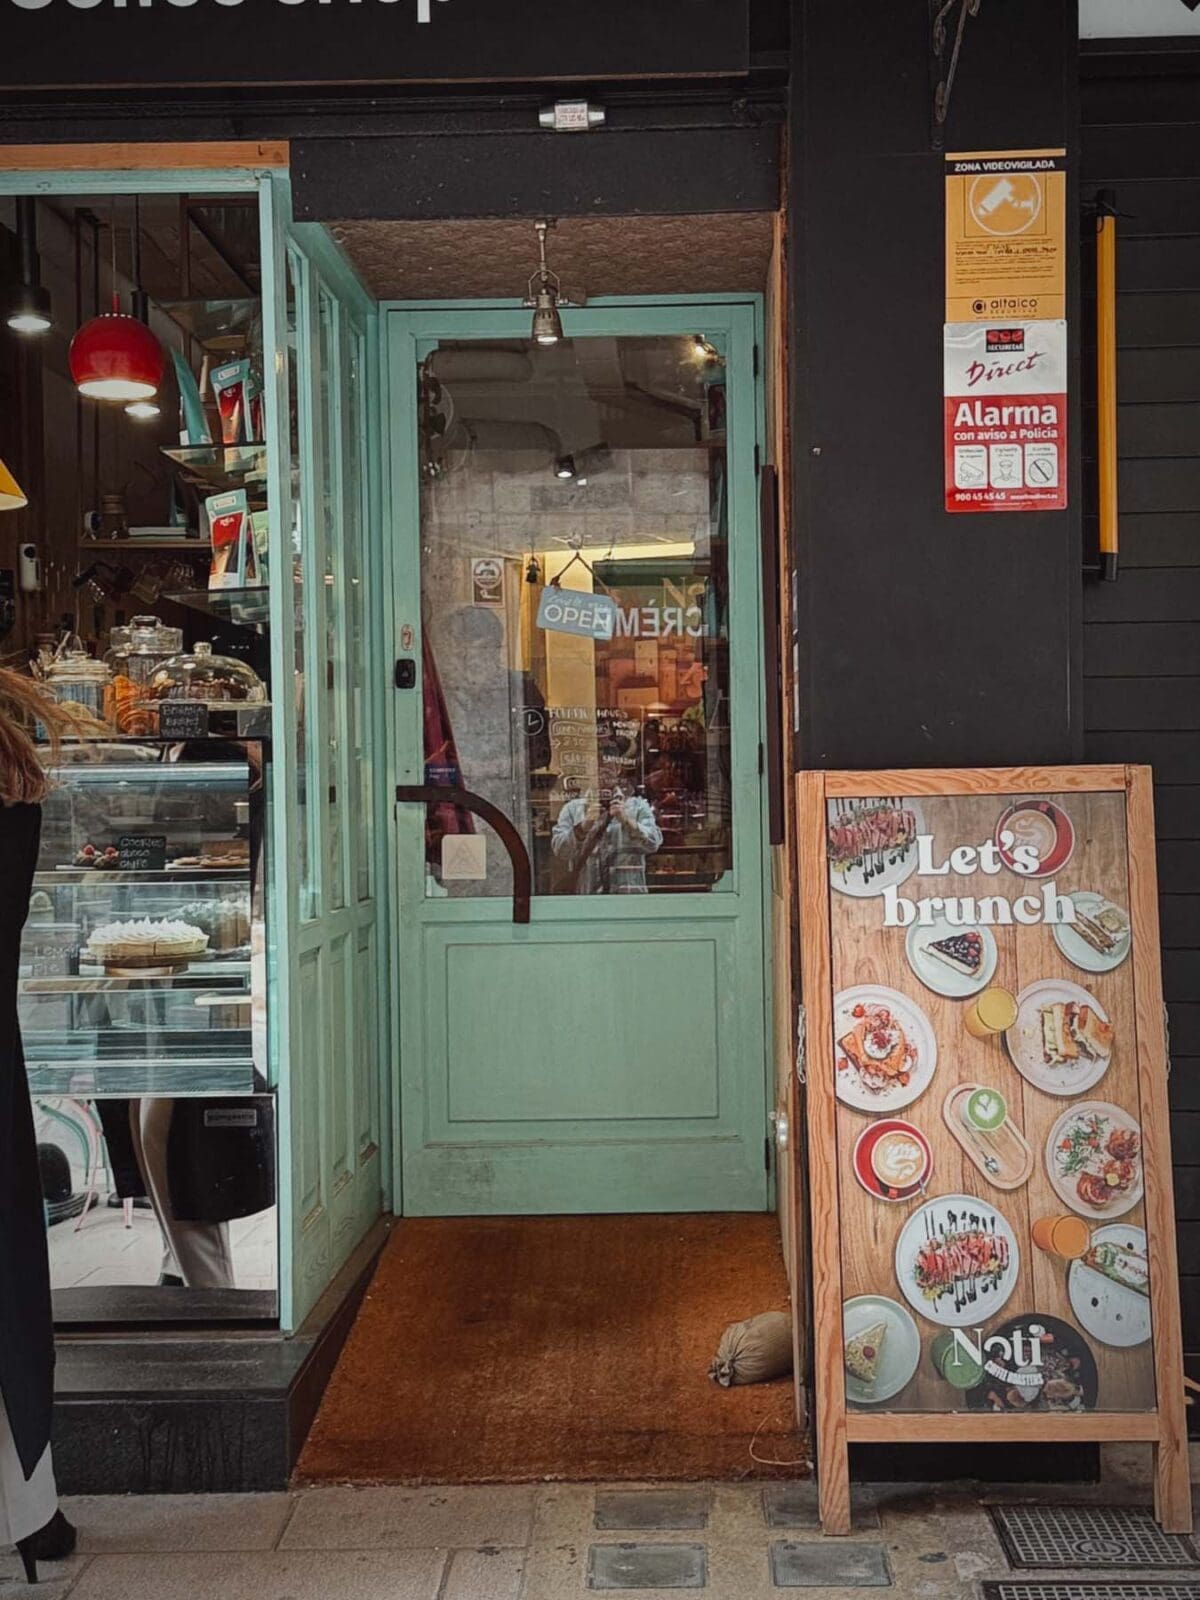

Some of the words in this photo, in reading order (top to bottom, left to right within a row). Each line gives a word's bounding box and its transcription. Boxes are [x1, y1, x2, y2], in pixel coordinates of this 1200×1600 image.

[954, 163, 981, 172] ZONA
[982, 160, 1055, 171] VIDEOVIGILADA
[990, 298, 1038, 309] altaico
[965, 351, 1048, 387] Direct
[954, 400, 1058, 427] Alarma
[954, 431, 975, 441] con
[977, 427, 1007, 440] aviso
[1009, 430, 1017, 439] a
[543, 603, 613, 634] OPEN
[916, 830, 1041, 875] Let's
[880, 880, 1077, 926] brunch
[950, 1324, 1046, 1367] Noti
